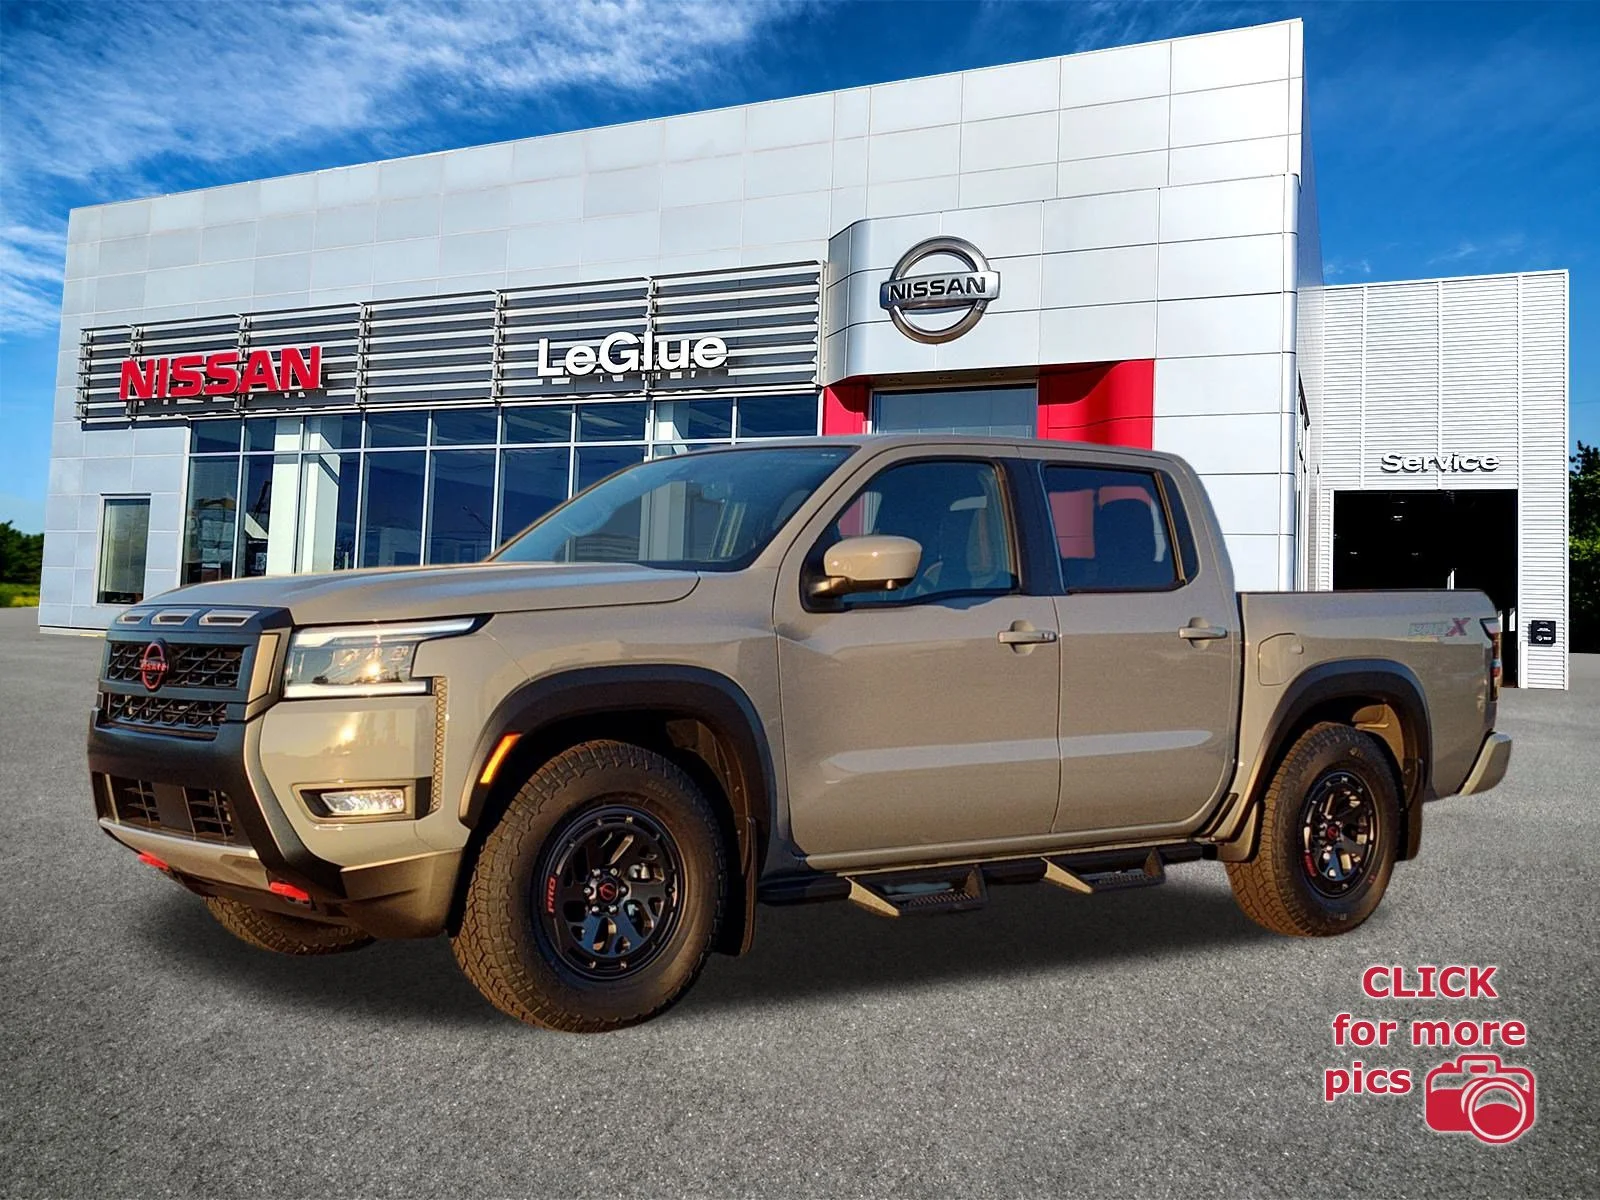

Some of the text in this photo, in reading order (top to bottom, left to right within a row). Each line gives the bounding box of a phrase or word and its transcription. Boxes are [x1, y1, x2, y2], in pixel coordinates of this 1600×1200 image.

[887, 276, 986, 302] NISSAN
[537, 331, 729, 377] LeGlue
[119, 345, 322, 400] NISSAN
[1381, 451, 1500, 473] Service
